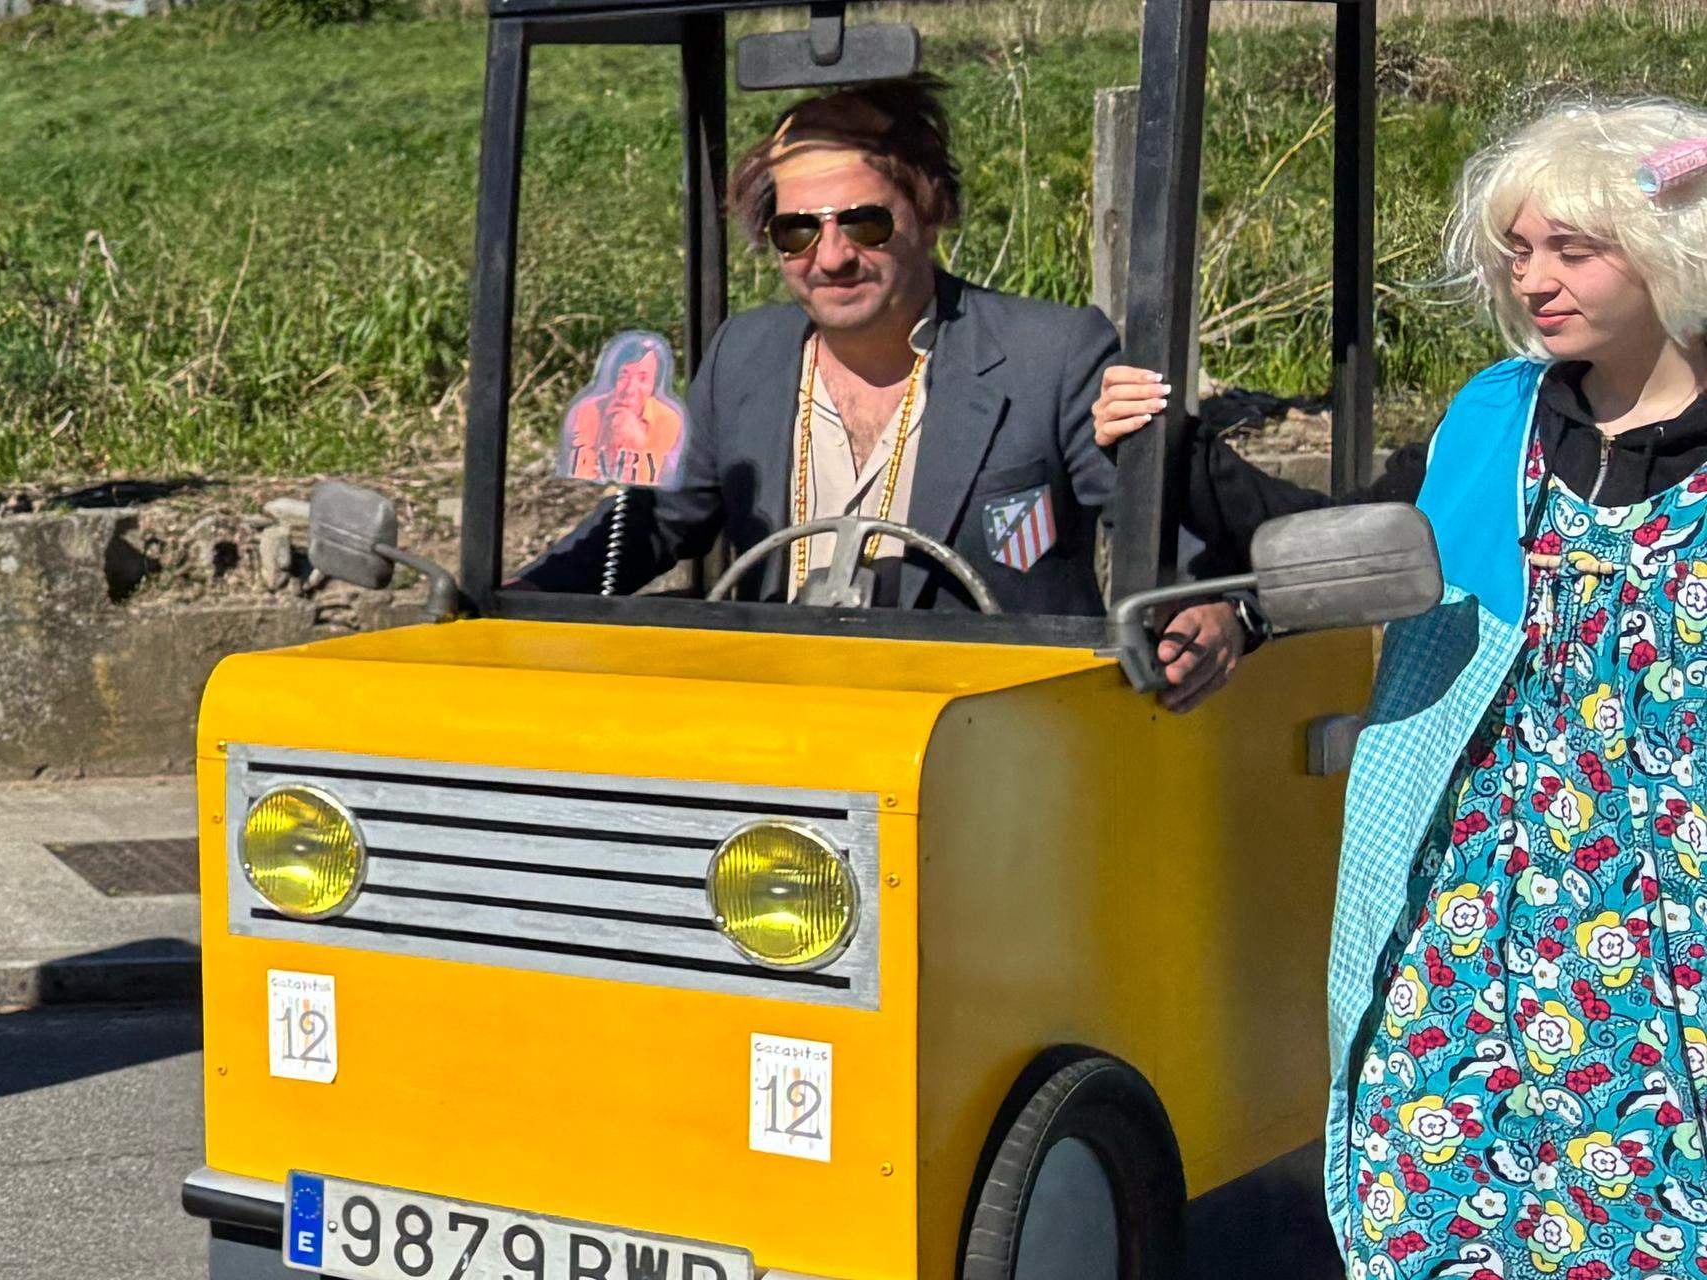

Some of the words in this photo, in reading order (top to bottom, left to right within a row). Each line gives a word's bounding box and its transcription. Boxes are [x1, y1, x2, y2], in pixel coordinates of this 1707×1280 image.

[276, 1007, 331, 1063] 12
[757, 1074, 823, 1140] 12
[298, 1230, 315, 1253] E
